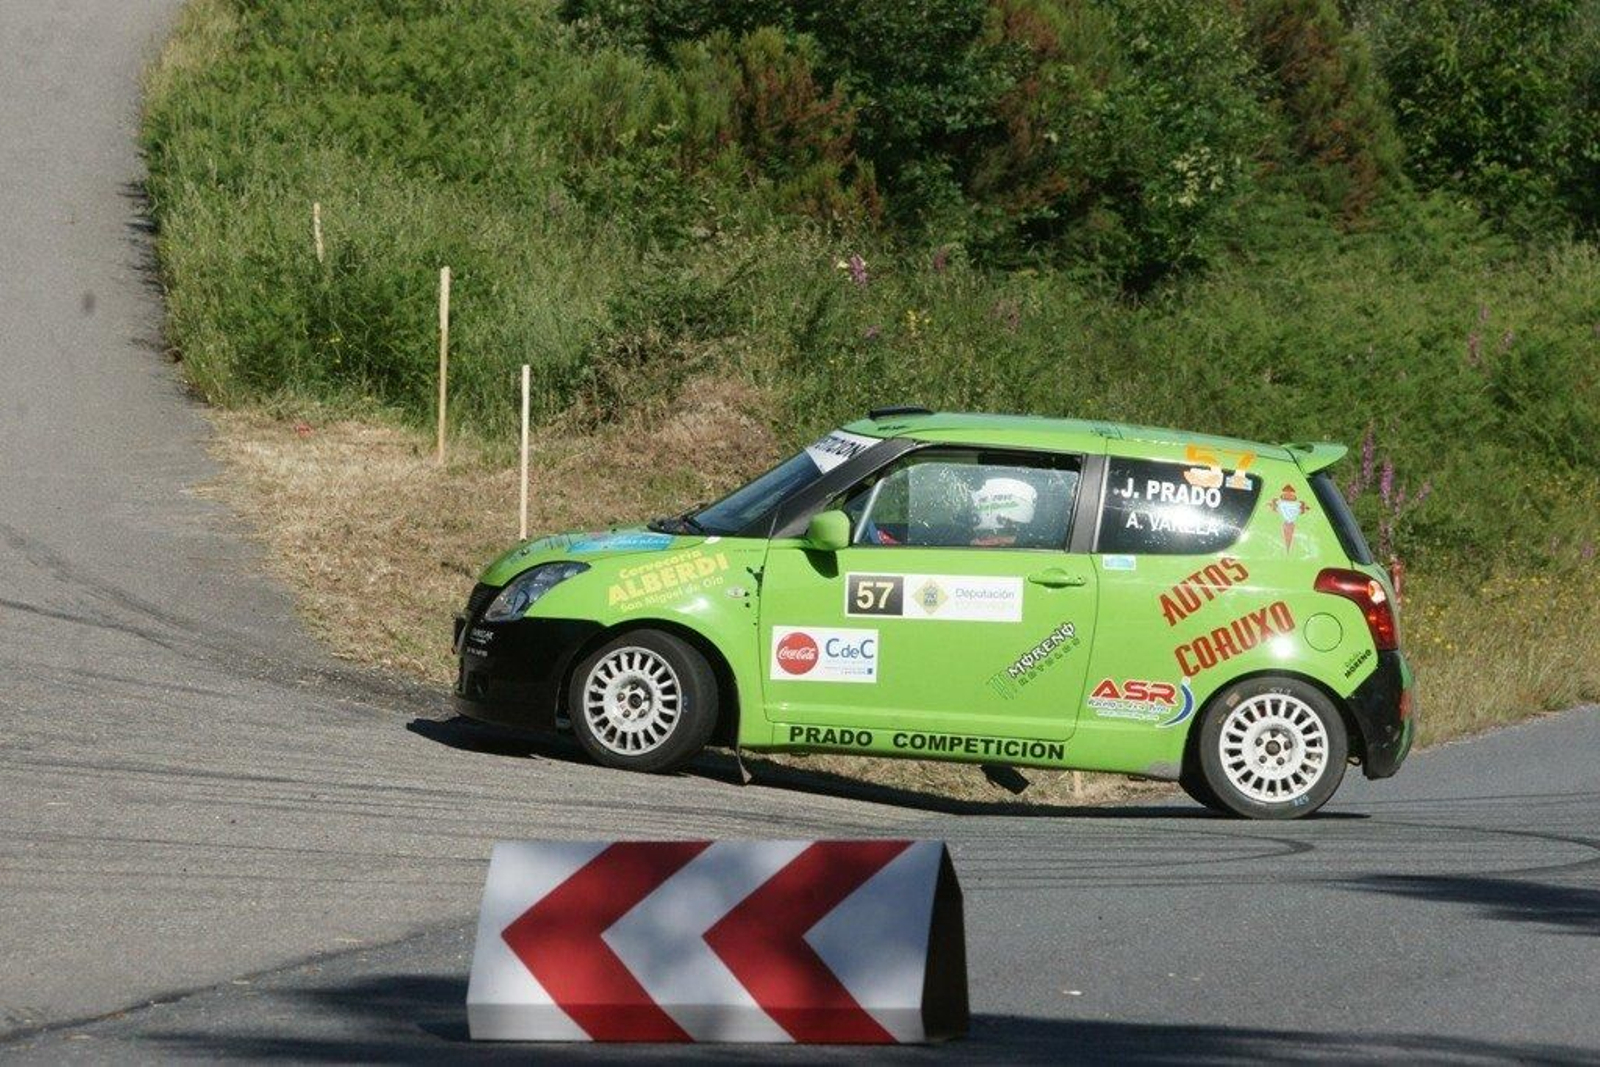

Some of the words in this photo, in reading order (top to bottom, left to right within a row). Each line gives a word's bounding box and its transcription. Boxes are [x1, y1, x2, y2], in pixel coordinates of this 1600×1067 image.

[1184, 444, 1256, 488] 57
[1121, 478, 1140, 499] J.
[1146, 480, 1221, 508] PRADO
[1125, 511, 1144, 529] A.
[608, 553, 730, 606] ALBERDI
[856, 580, 895, 610] 57
[955, 587, 1015, 600] Deputación
[1159, 557, 1249, 627] AUTOS
[1174, 601, 1296, 677] CORUXO
[1090, 679, 1177, 705] ASR
[789, 726, 874, 747] PRADO
[892, 733, 1065, 760] COMPETICIÓN
